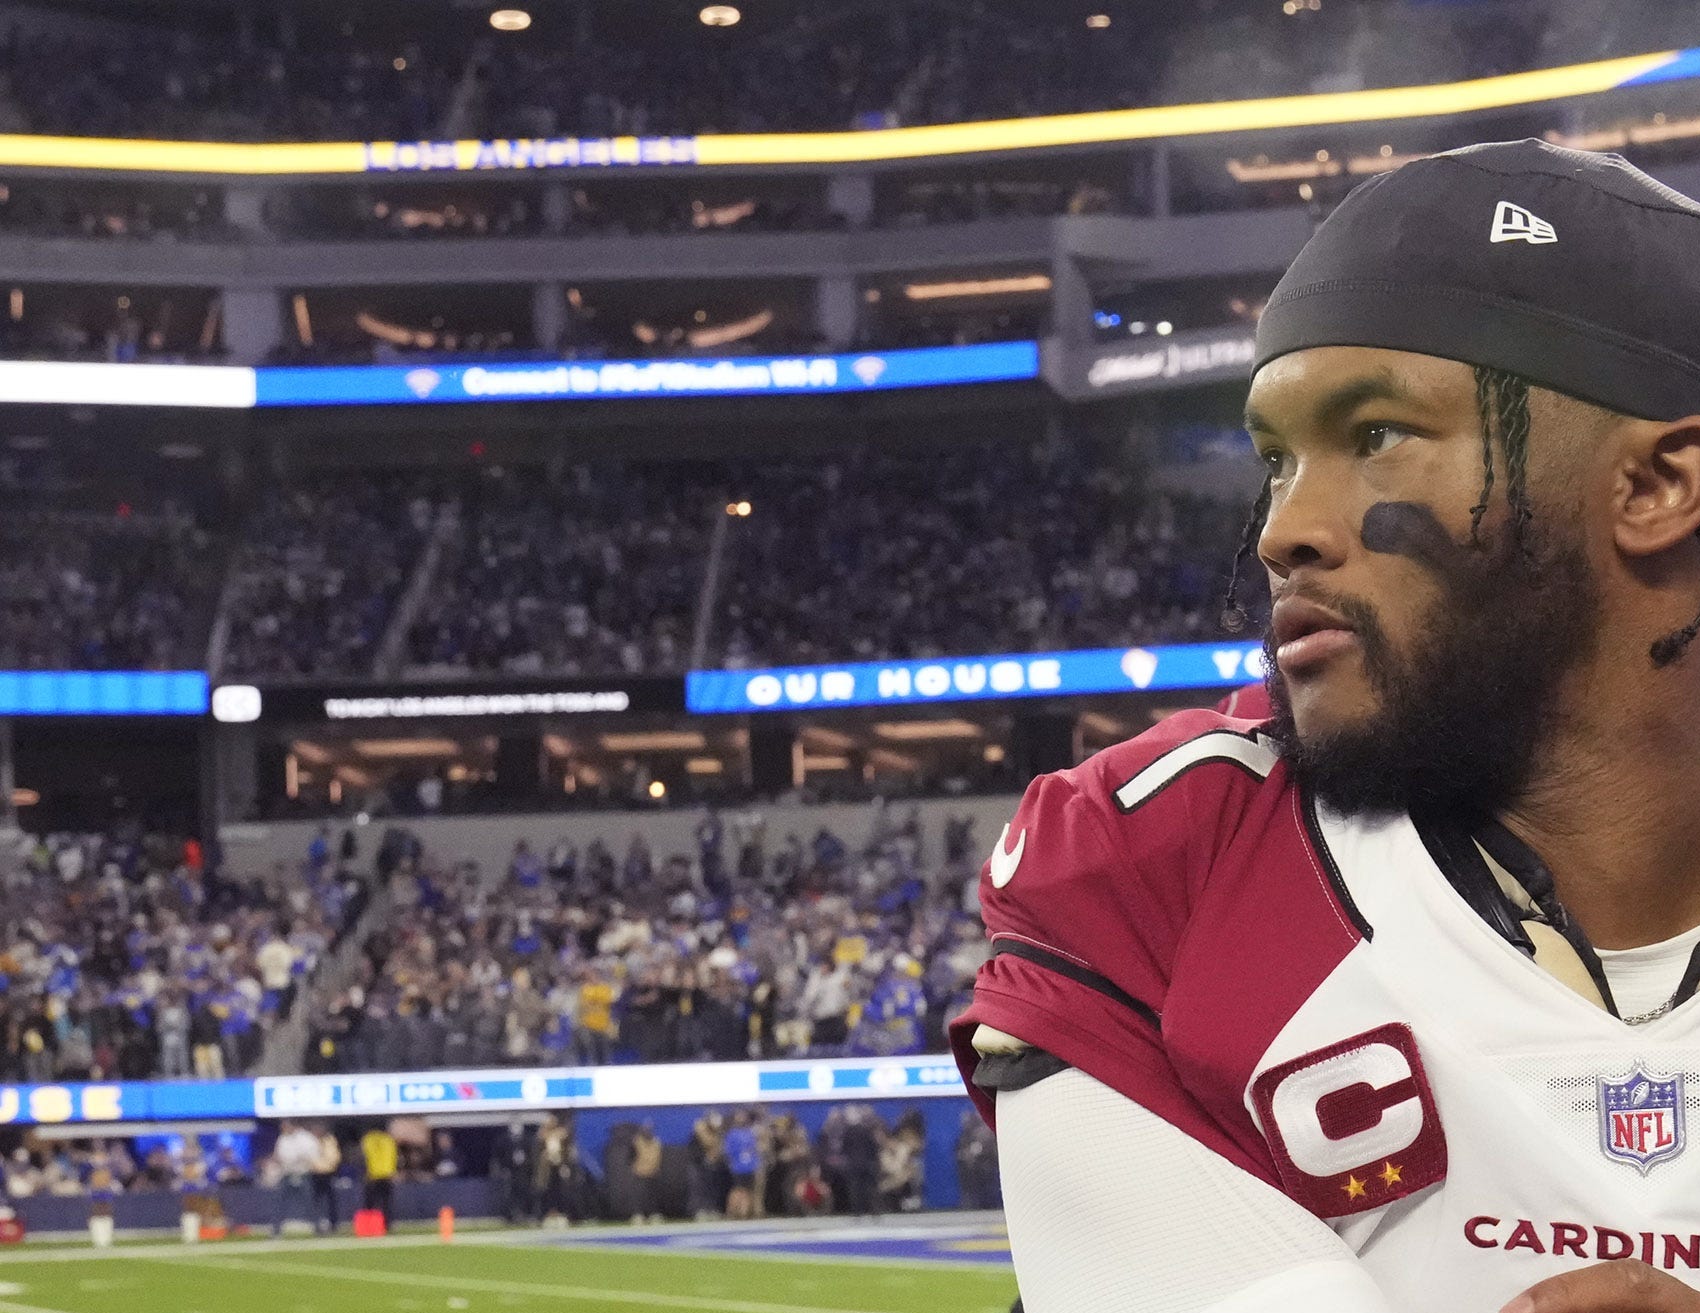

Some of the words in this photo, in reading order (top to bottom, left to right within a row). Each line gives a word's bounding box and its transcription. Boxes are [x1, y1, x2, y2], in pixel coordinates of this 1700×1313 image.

[746, 671, 855, 706] OUR
[877, 659, 1062, 697] HOUSE
[1272, 1042, 1424, 1178] C
[1612, 1112, 1673, 1154] NFL
